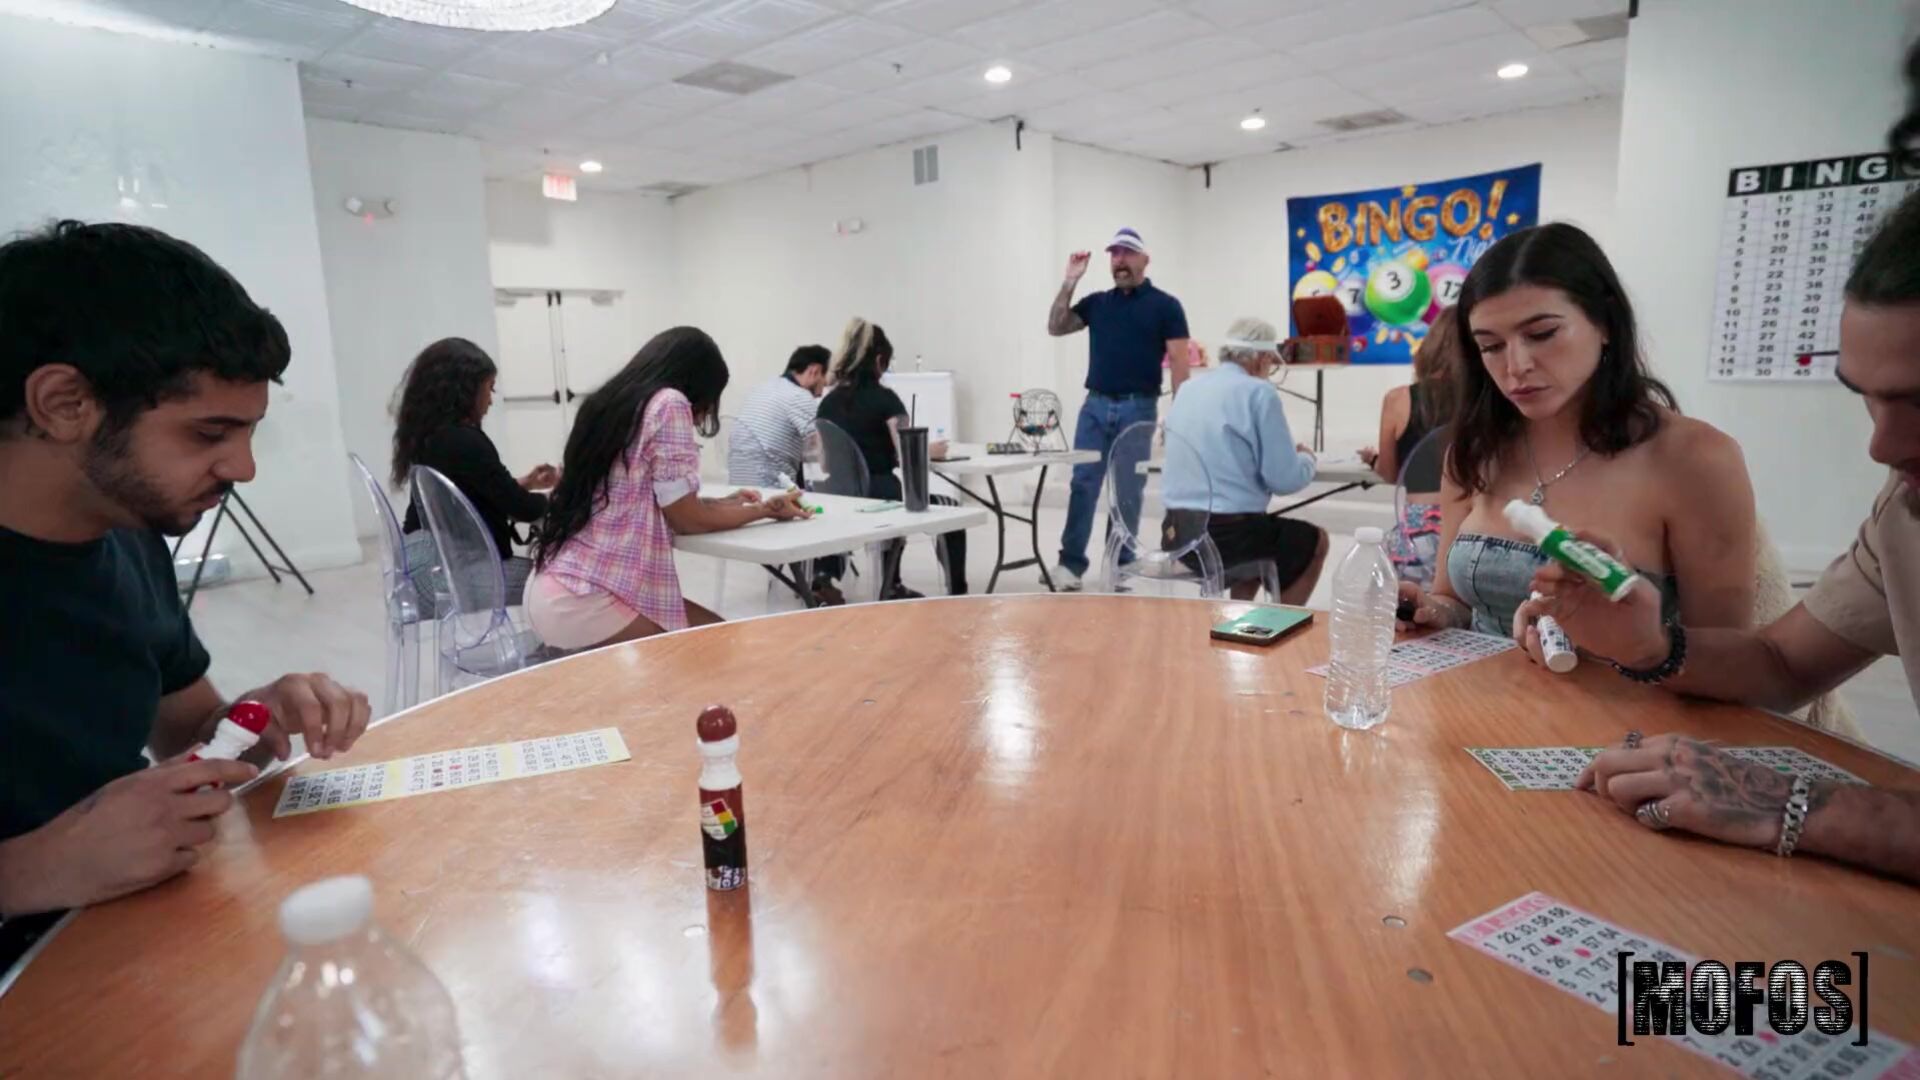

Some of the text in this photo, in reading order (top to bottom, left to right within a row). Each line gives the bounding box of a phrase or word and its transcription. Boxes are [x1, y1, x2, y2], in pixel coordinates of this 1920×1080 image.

[1777, 193, 1793, 202] 16
[1817, 190, 1834, 200] 31
[1776, 206, 1793, 216] 17
[1817, 203, 1834, 213] 32
[1858, 199, 1877, 209] 47
[1318, 180, 1508, 253] BINGO!
[1774, 219, 1791, 228] 18
[1814, 216, 1832, 226] 33
[1773, 232, 1790, 241] 19
[1813, 229, 1830, 239] 34
[1770, 244, 1788, 255] 20
[1811, 241, 1829, 251] 35
[1768, 257, 1785, 267] 21
[1809, 255, 1827, 265] 36
[1767, 270, 1784, 279] 22
[1808, 267, 1825, 277] 37
[1386, 271, 1402, 290] 3
[1765, 282, 1783, 292] 23
[1806, 281, 1823, 290] 38
[1348, 287, 1360, 305] 7
[1763, 295, 1781, 304] 24
[1804, 293, 1822, 302] 39
[1725, 305, 1820, 317] 10 25 40
[1724, 319, 1817, 329] 11 26 41
[1722, 331, 1816, 342] 12 27 42
[1721, 344, 1815, 353] 13 28 43
[1720, 356, 1774, 365] 14 29
[1718, 367, 1811, 377] 15 30 45
